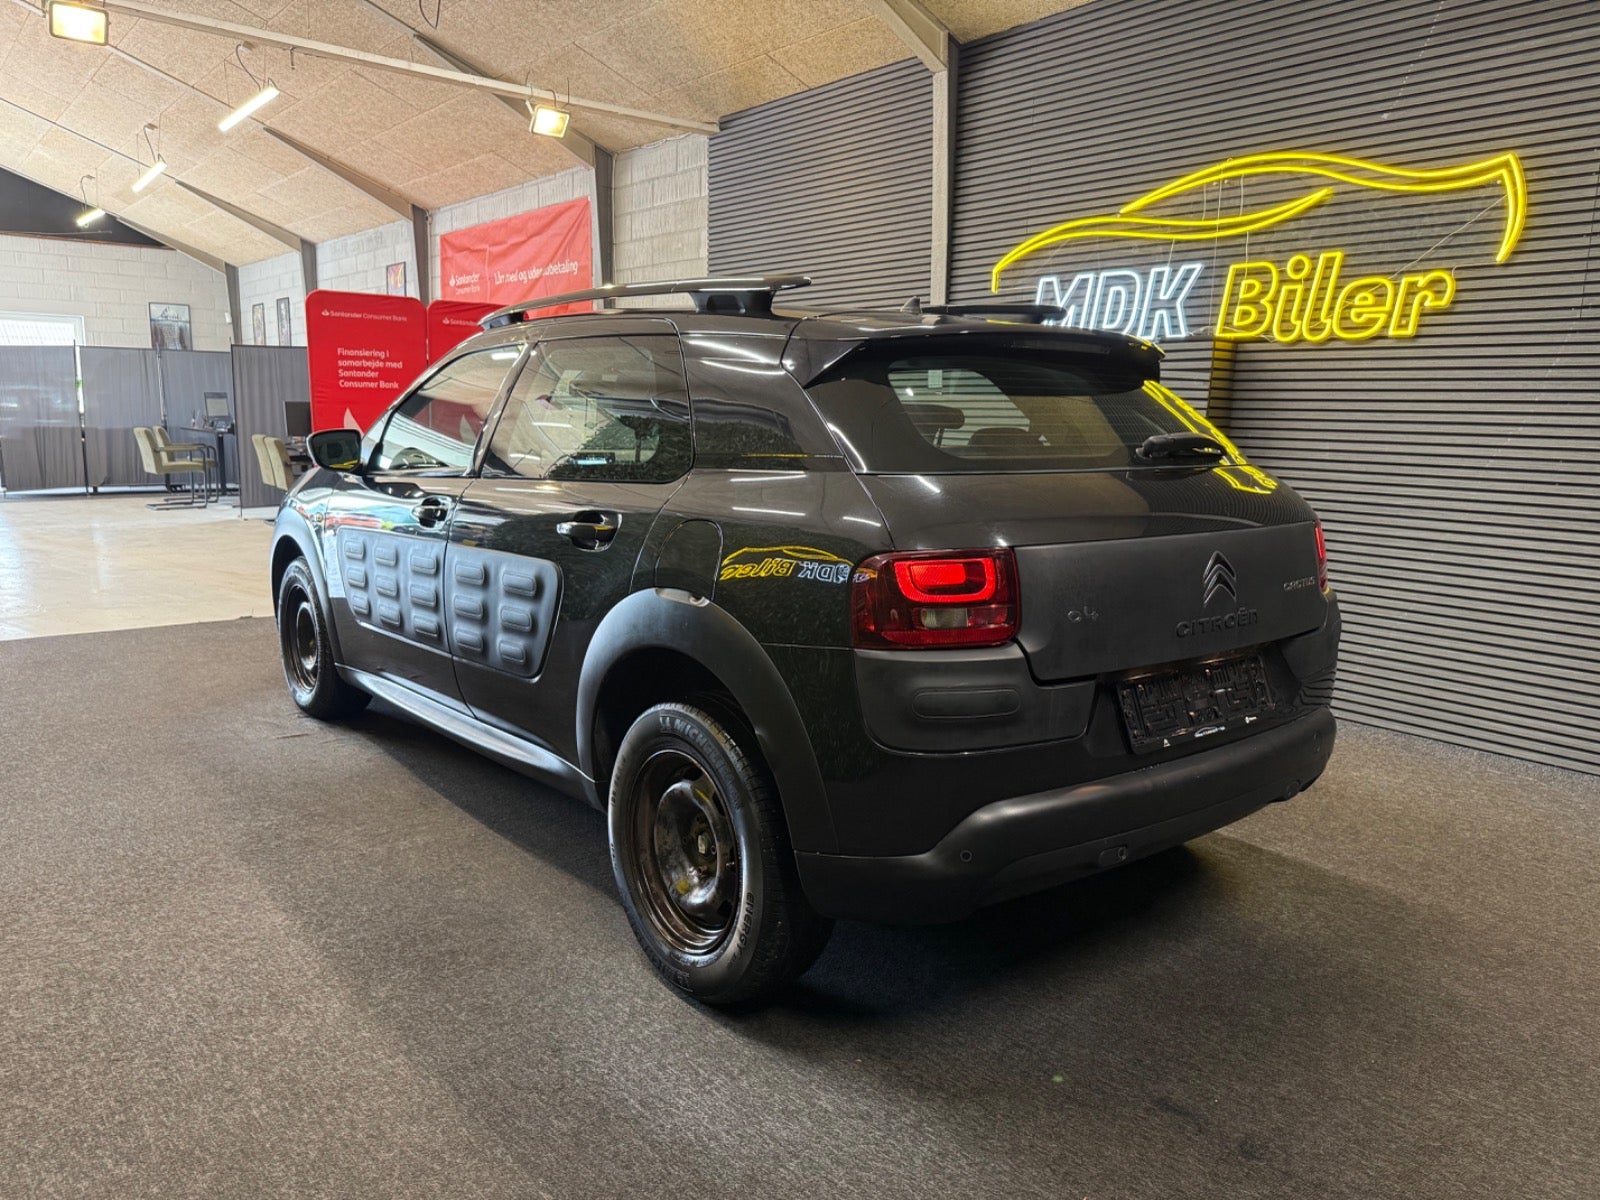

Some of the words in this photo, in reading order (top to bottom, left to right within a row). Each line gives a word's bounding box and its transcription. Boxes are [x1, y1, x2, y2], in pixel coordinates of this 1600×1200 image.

[1034, 263, 1204, 341] MDK
[1215, 251, 1456, 342] Biler
[330, 310, 362, 318] Santander
[450, 318, 478, 326] Santande
[337, 347, 385, 360] Finansiering
[338, 359, 384, 370] samarbejde
[385, 361, 403, 369] med
[338, 369, 379, 378] Santander
[339, 379, 378, 389] Consumer
[379, 380, 399, 389] Bank
[736, 891, 755, 956] ENERGY
